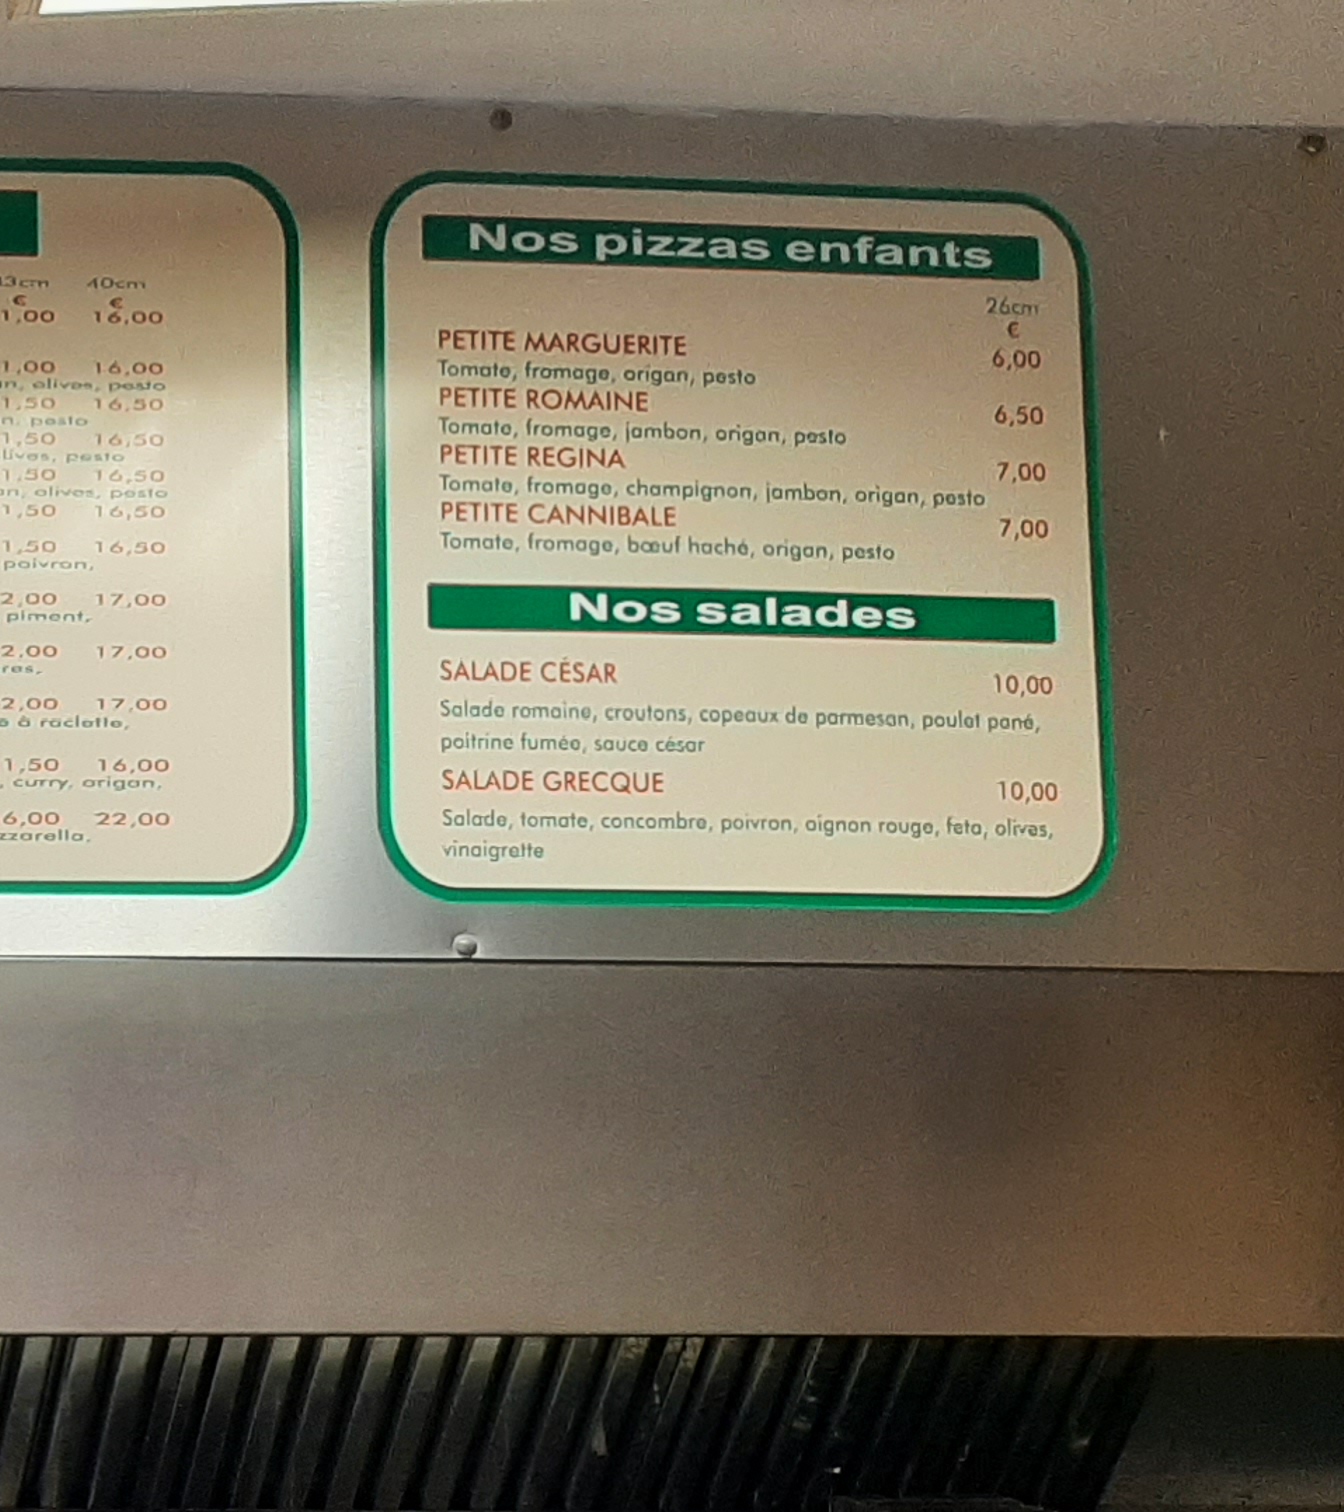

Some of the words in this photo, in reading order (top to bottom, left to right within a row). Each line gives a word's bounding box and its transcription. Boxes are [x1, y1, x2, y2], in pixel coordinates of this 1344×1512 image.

[469, 222, 579, 253] Nos
[595, 228, 771, 262] pizzas
[785, 236, 993, 268] enfants
[438, 329, 516, 352] PETITE
[524, 331, 687, 357] MARGUERITE
[991, 347, 1042, 372] 6,00
[436, 358, 518, 383] Tomate,
[524, 359, 617, 386] fromage,
[623, 363, 695, 388] origan,
[702, 368, 756, 389] pesto
[439, 386, 517, 409] PETITE
[526, 388, 649, 413] ROMAINE
[994, 404, 1044, 428] 6,50
[437, 415, 519, 440] Tomate,
[525, 417, 618, 443] fromage,
[625, 420, 708, 444] jambon,
[715, 423, 787, 447] origan,
[794, 429, 847, 448] pesto
[440, 443, 518, 467] PETITE
[527, 445, 626, 469] REGINA
[996, 461, 1046, 485] 7,00
[438, 473, 519, 496] Tomate,
[526, 475, 619, 500] fromage,
[625, 477, 758, 503] champignon,
[765, 481, 848, 505] jambon,
[854, 484, 926, 509] origan,
[932, 488, 986, 510] pesto
[441, 501, 519, 524] PETITE
[527, 502, 676, 527] CANNIBALE
[999, 517, 1049, 542] 7,00
[95, 592, 167, 609] 17,00
[570, 592, 682, 624] Nos
[696, 597, 916, 630] salades
[440, 659, 532, 683] SALADE
[540, 657, 618, 684] CÉSAR
[994, 673, 1053, 698] 10,00
[439, 698, 505, 718] Salade
[511, 700, 598, 724] romaine,
[604, 704, 693, 726] croutons,
[699, 708, 779, 728] copeaux
[784, 705, 809, 725] de
[815, 711, 916, 730] parmesan,
[921, 709, 981, 732] poulet
[440, 731, 515, 754] poitrine
[593, 738, 649, 753] sauce
[441, 768, 534, 792] SALADE
[542, 770, 664, 795] GRECQUE
[997, 780, 1058, 806] 10,00
[94, 811, 171, 829] 22,00
[442, 808, 514, 831] Salade,
[519, 811, 594, 832] tomate,
[600, 811, 714, 833] concombre,
[720, 814, 799, 834] poivron,
[804, 814, 872, 837] oignon
[877, 820, 940, 839] rouge,
[945, 819, 988, 841] feta,
[994, 820, 1054, 840] olives,
[443, 839, 545, 863] vinaigrette
